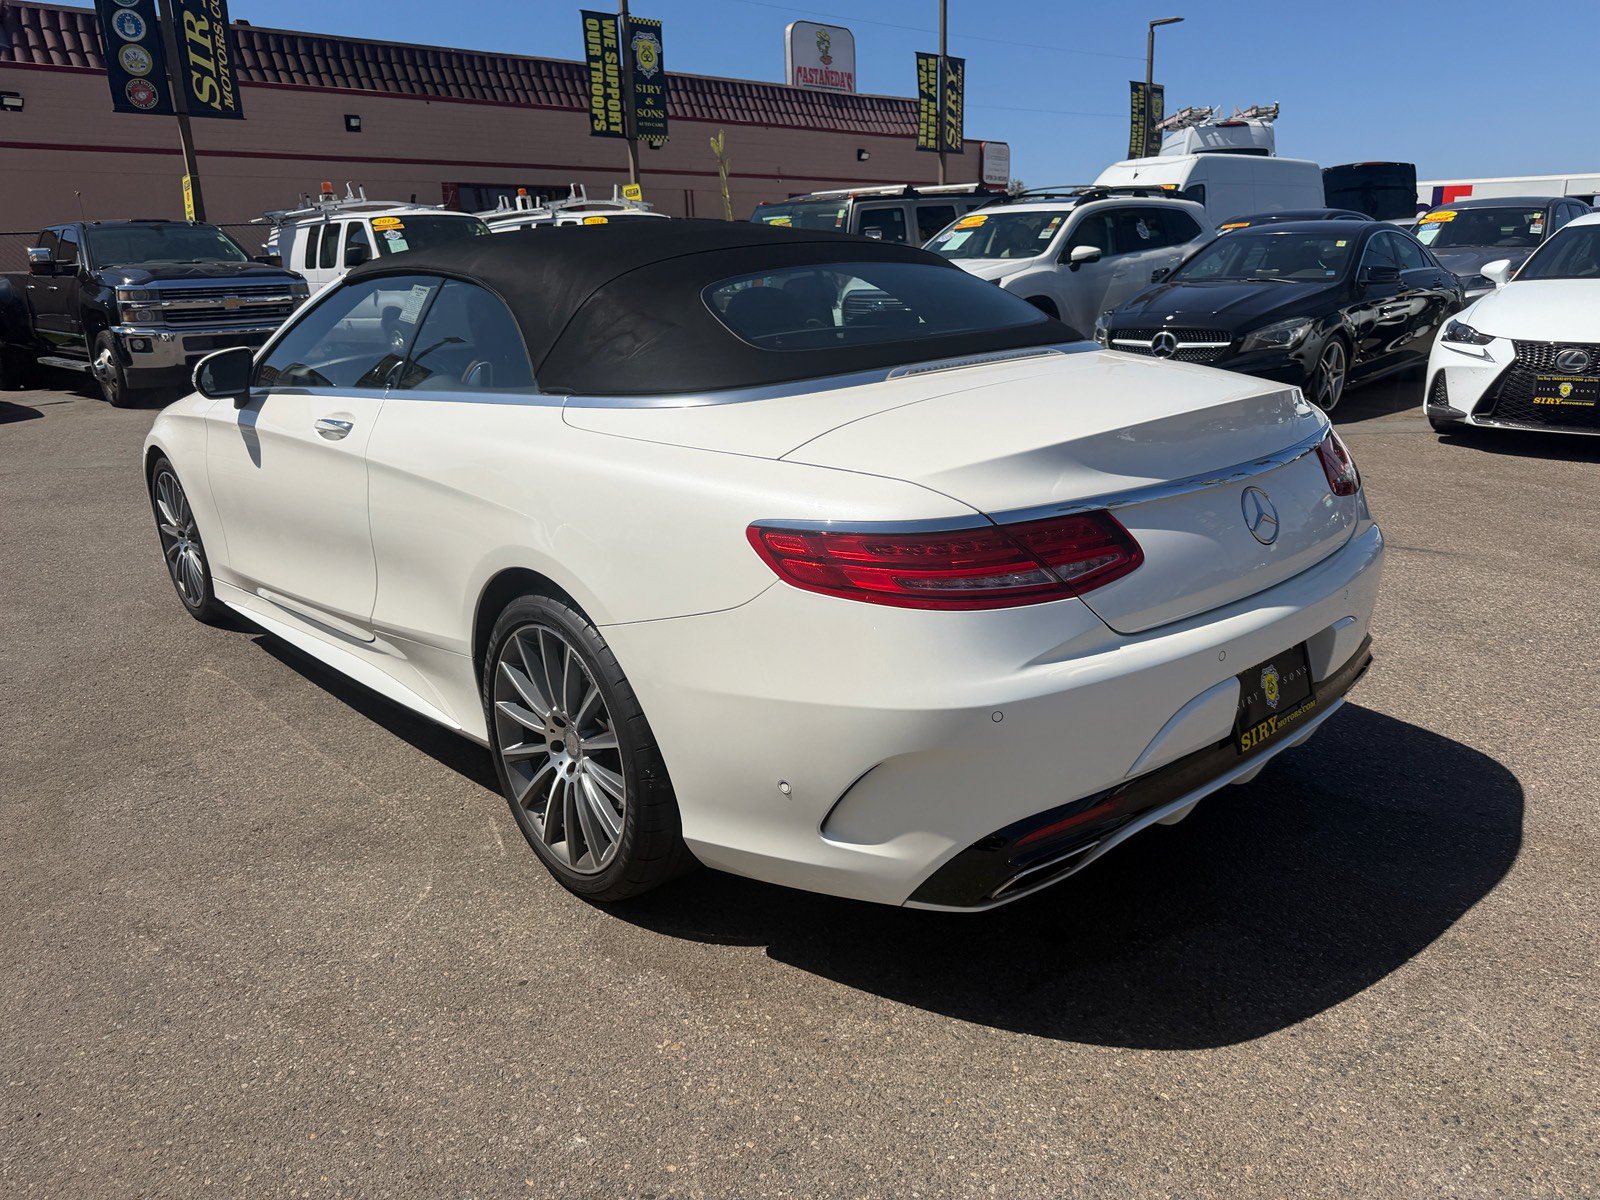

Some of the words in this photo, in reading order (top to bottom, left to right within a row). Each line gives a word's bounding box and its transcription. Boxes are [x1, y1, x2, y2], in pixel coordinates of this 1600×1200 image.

[586, 18, 601, 56] OUR
[602, 19, 617, 48] WE
[182, 0, 222, 111] SIR
[605, 51, 623, 134] SUPPORT
[635, 84, 662, 94] SIRY
[918, 58, 928, 94] PAY
[928, 58, 937, 98] BUY
[590, 60, 607, 131] TROOPS
[636, 108, 665, 119] SONS
[645, 97, 654, 105] &
[945, 61, 958, 150] SIRY
[918, 98, 928, 147] HERE
[928, 101, 937, 149] HERE
[1130, 123, 1138, 152] CARE
[1283, 665, 1307, 685] SONS
